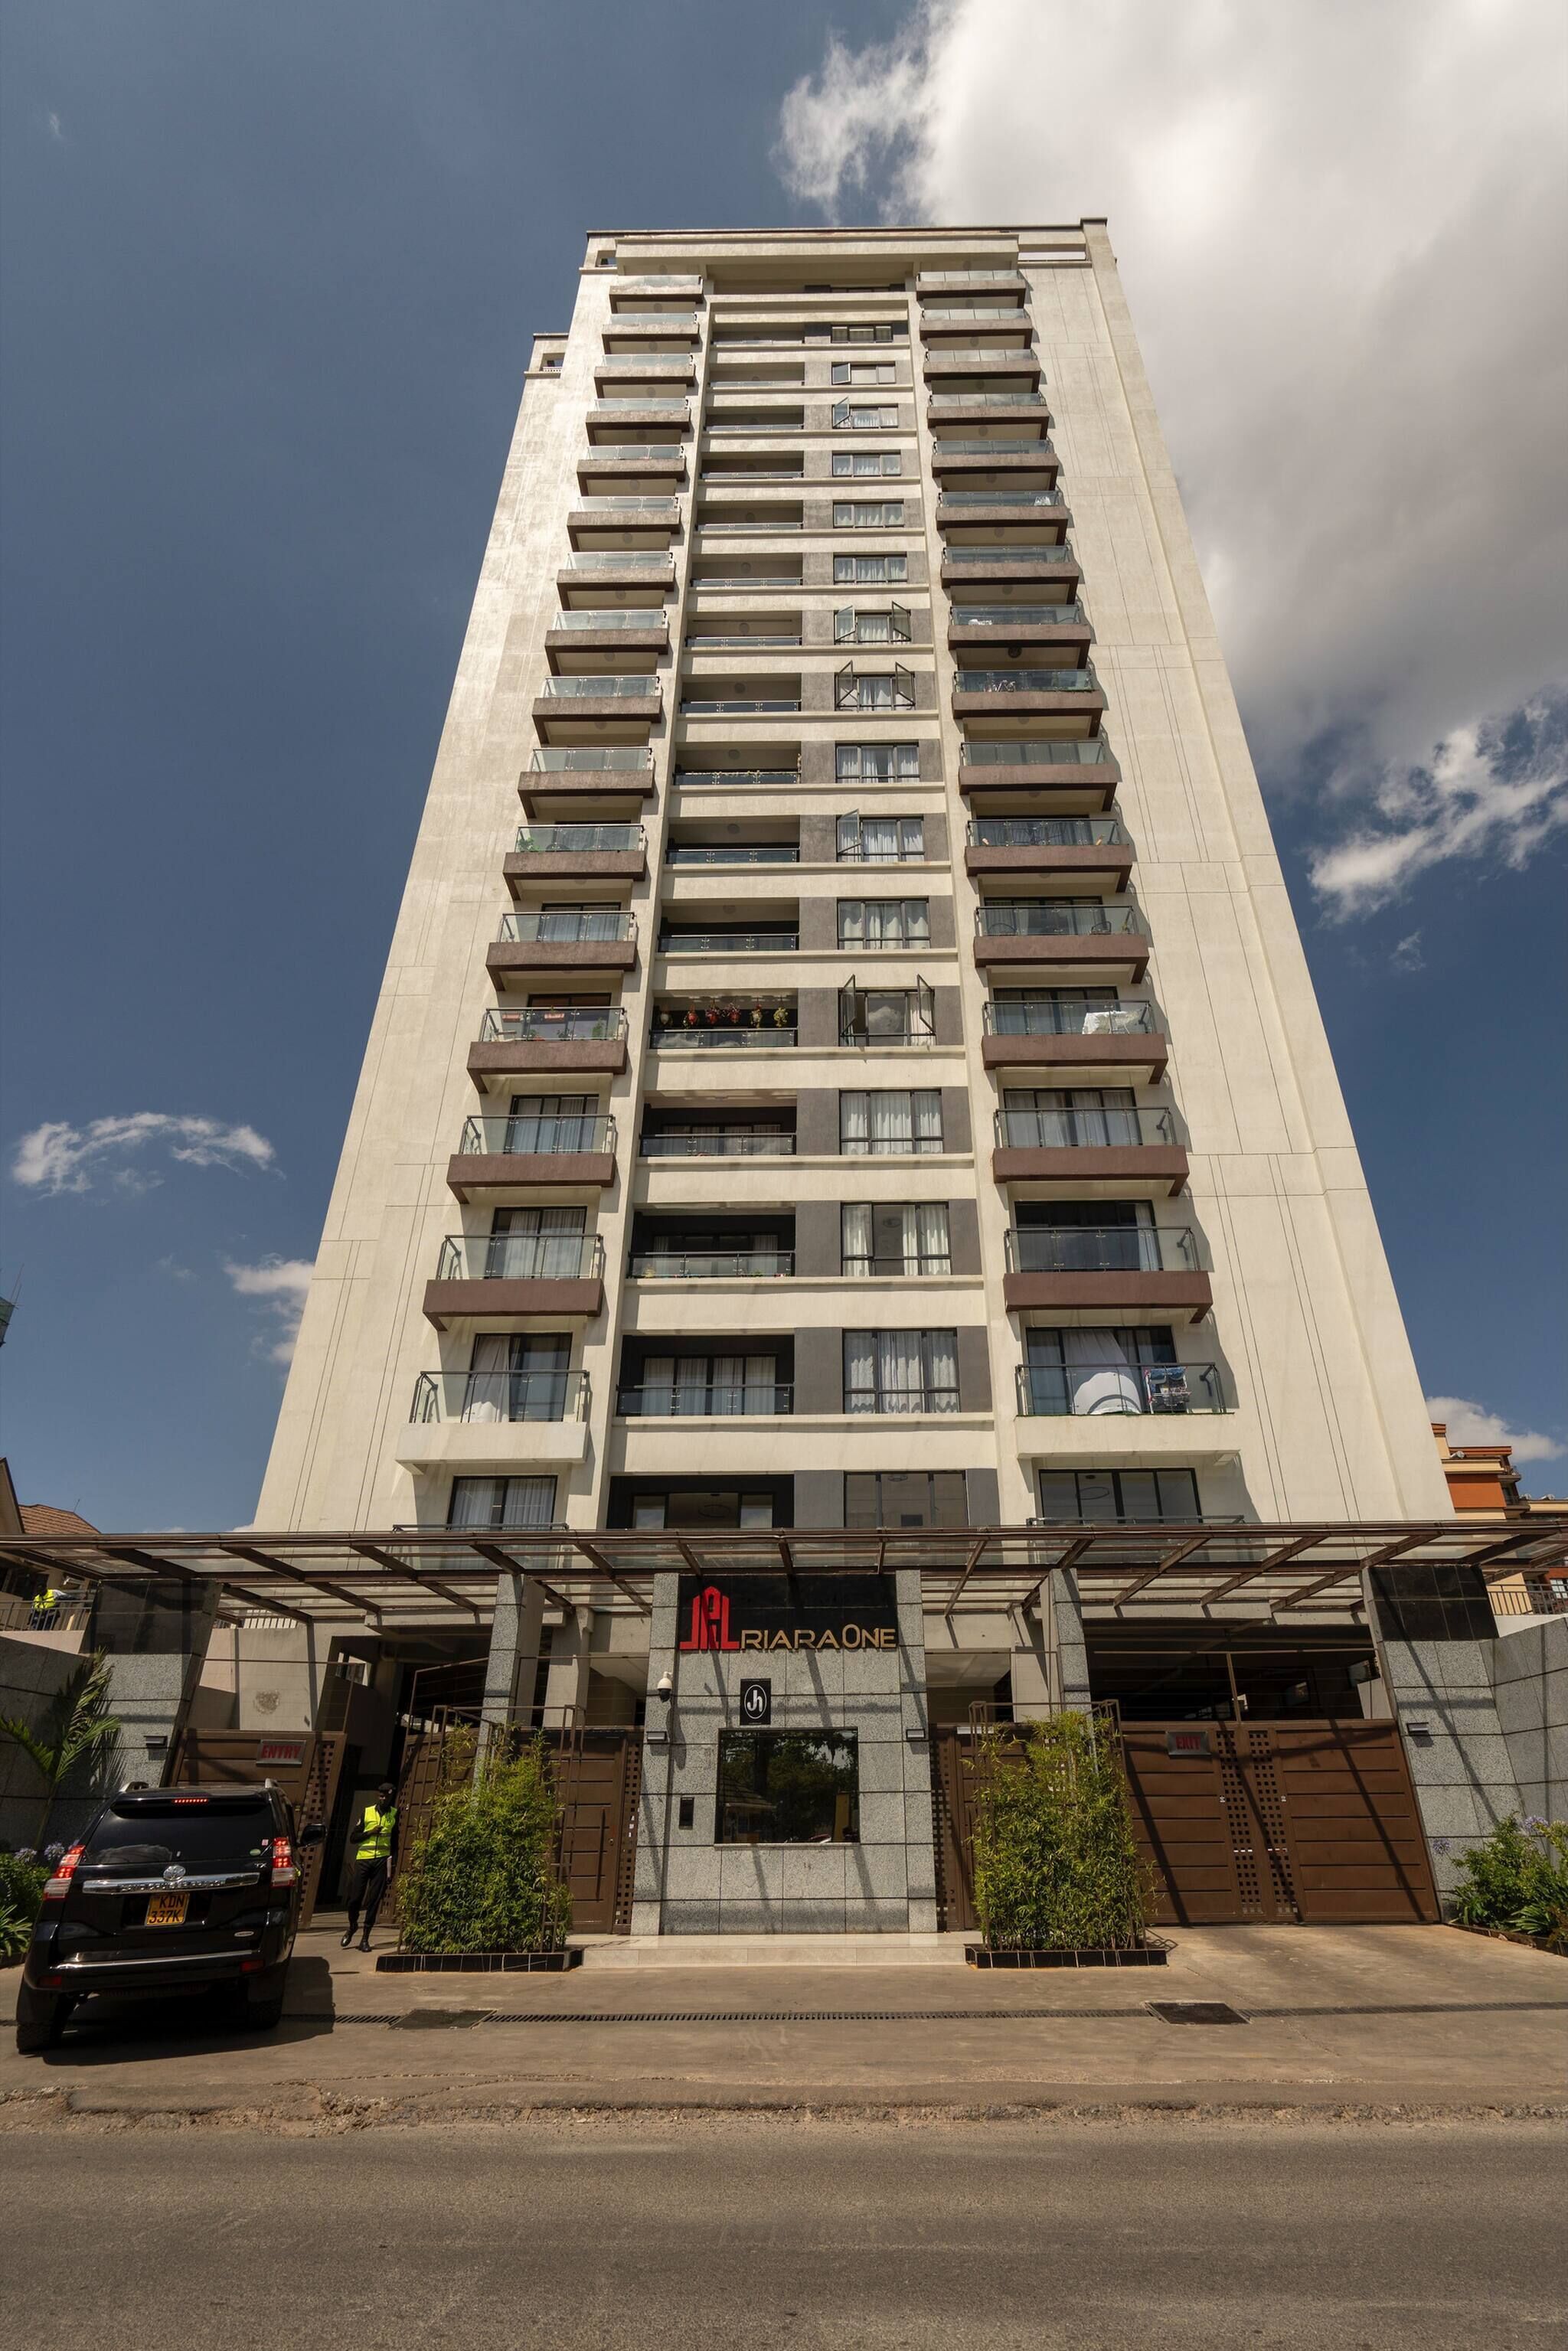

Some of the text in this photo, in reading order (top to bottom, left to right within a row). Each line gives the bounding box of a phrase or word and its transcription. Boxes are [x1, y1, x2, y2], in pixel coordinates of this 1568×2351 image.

[1176, 1736, 1200, 1750] EXIT
[262, 1745, 301, 1758] ENTRY
[159, 1895, 185, 1909] KDN
[149, 1909, 181, 1923] 337K
